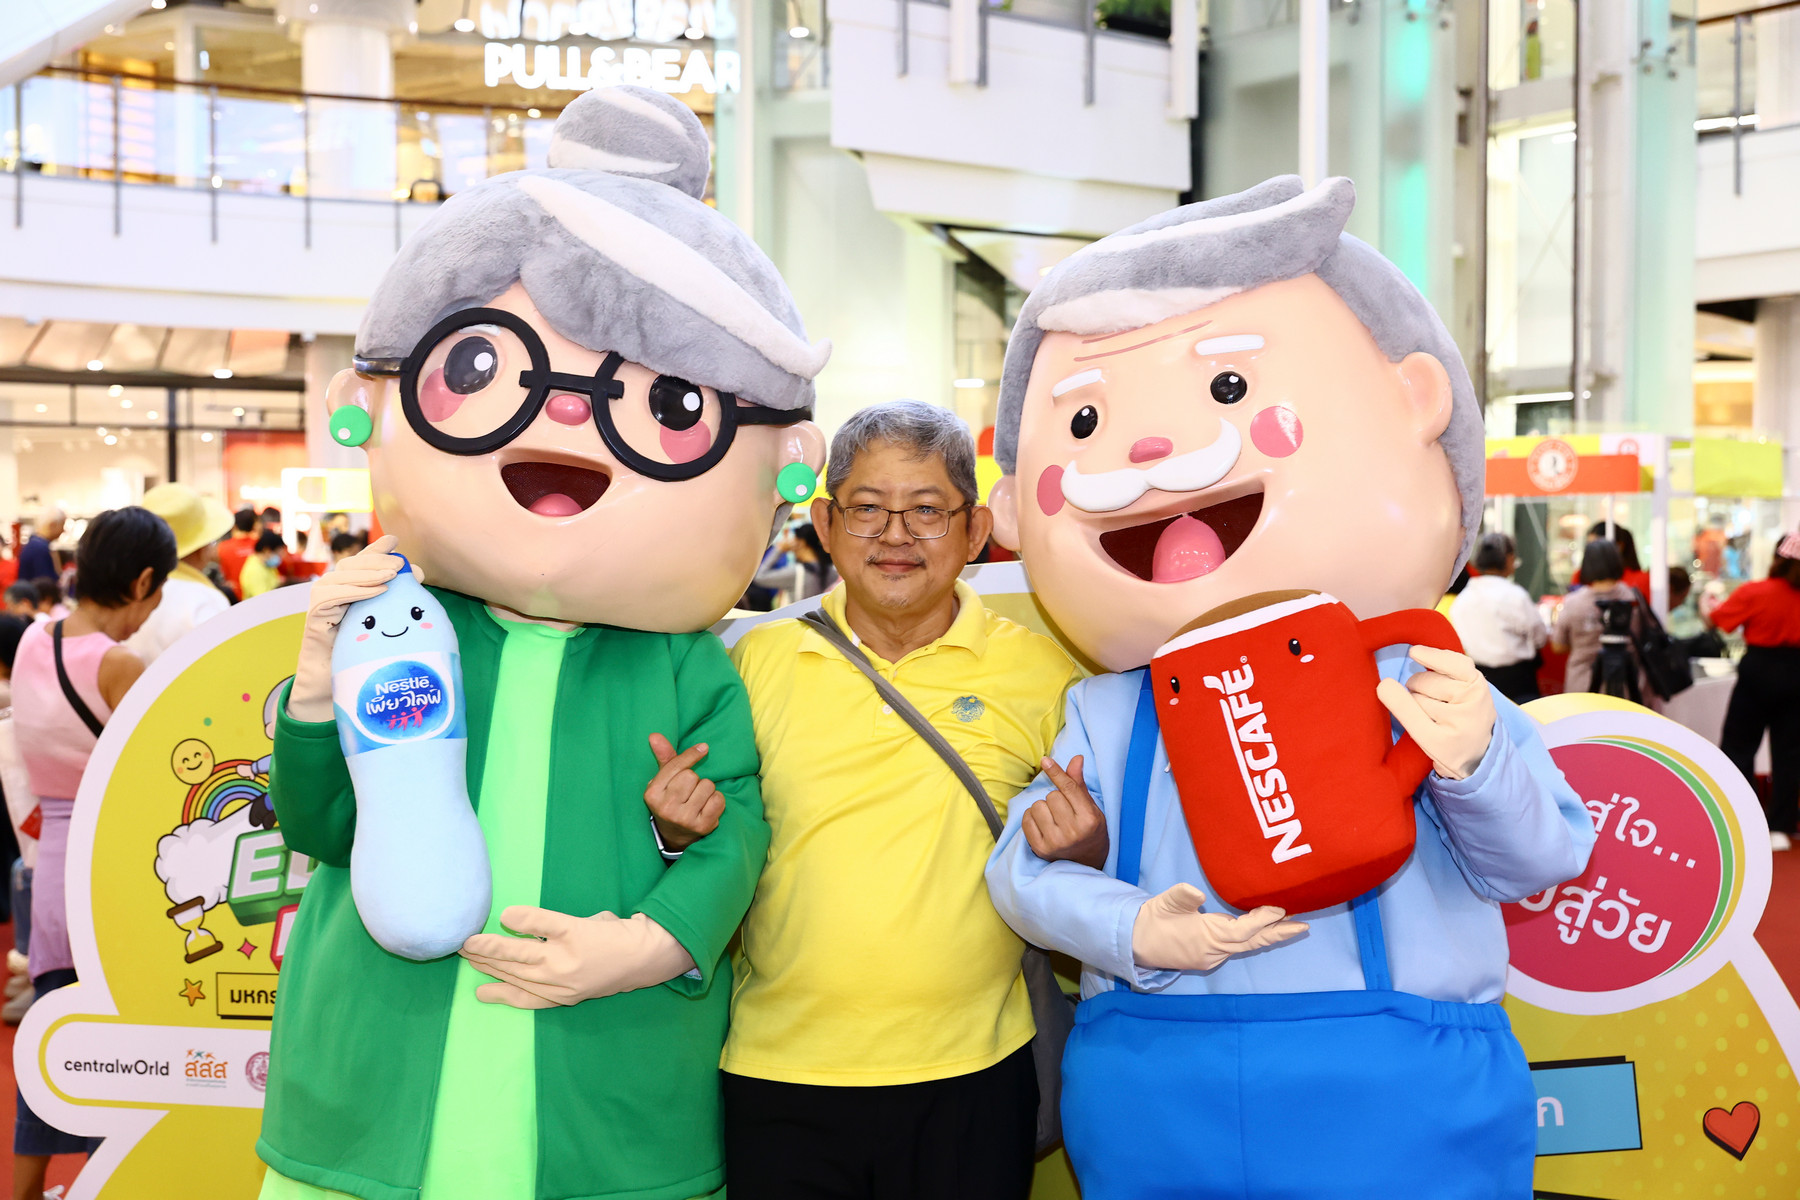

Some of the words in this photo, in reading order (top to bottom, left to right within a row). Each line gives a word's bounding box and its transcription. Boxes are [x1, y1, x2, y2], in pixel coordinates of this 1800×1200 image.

[484, 42, 741, 94] PULL&BEAR
[365, 688, 441, 715] เพียวไลฟ์
[1202, 663, 1312, 864] NESCAFÉ
[64, 1059, 170, 1076] centralwOrld
[185, 1060, 228, 1079] สสส
